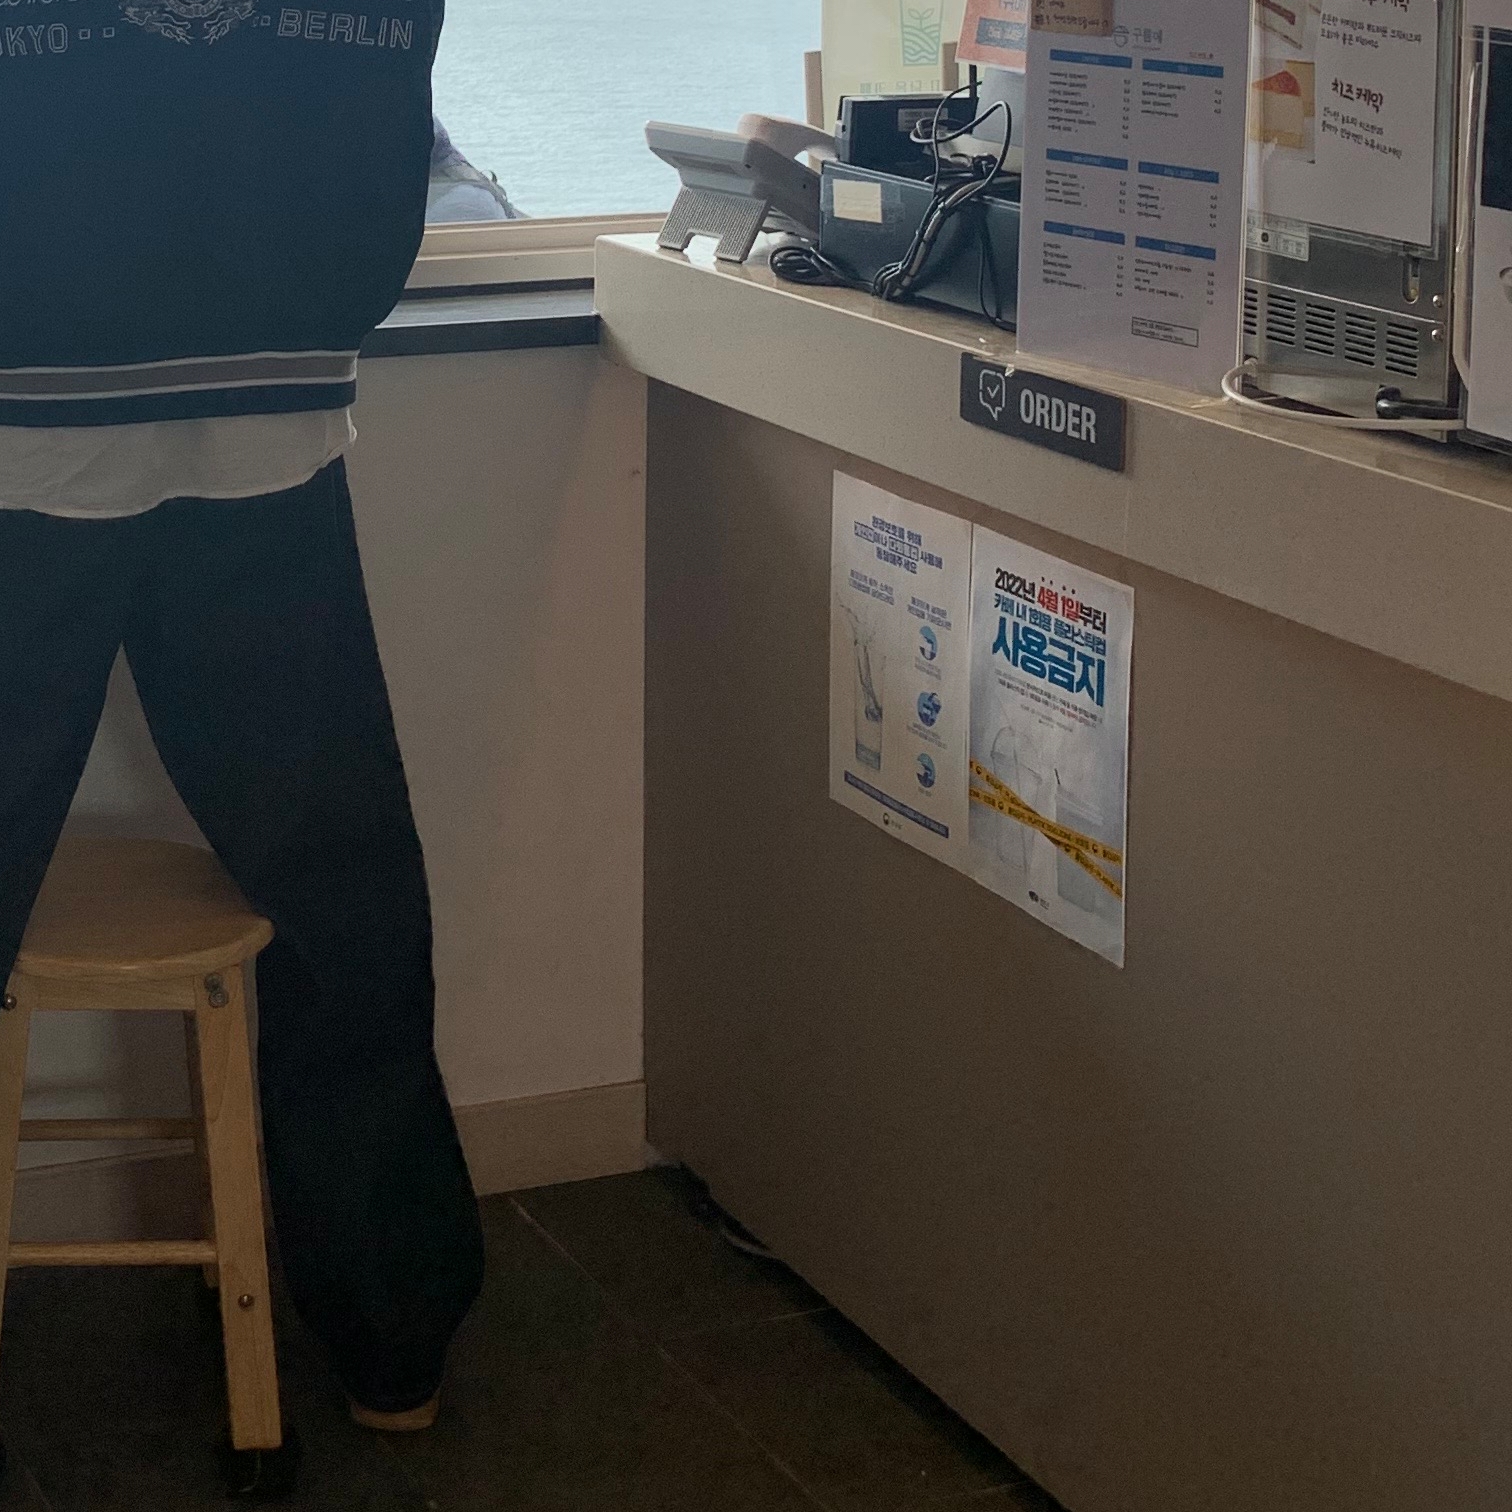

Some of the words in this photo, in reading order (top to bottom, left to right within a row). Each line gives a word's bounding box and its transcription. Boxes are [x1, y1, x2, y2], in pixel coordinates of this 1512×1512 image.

[277, 8, 414, 50] BERLIN
[1019, 388, 1096, 444] ORDER
[993, 592, 1015, 617] 카페
[1016, 602, 1027, 622] 내
[1053, 617, 1107, 656] 플라스틱컵
[994, 567, 1036, 604] 2022년
[1037, 585, 1059, 615] 4월
[1060, 595, 1107, 635] 1일부터
[991, 615, 1106, 708] 사용금지
